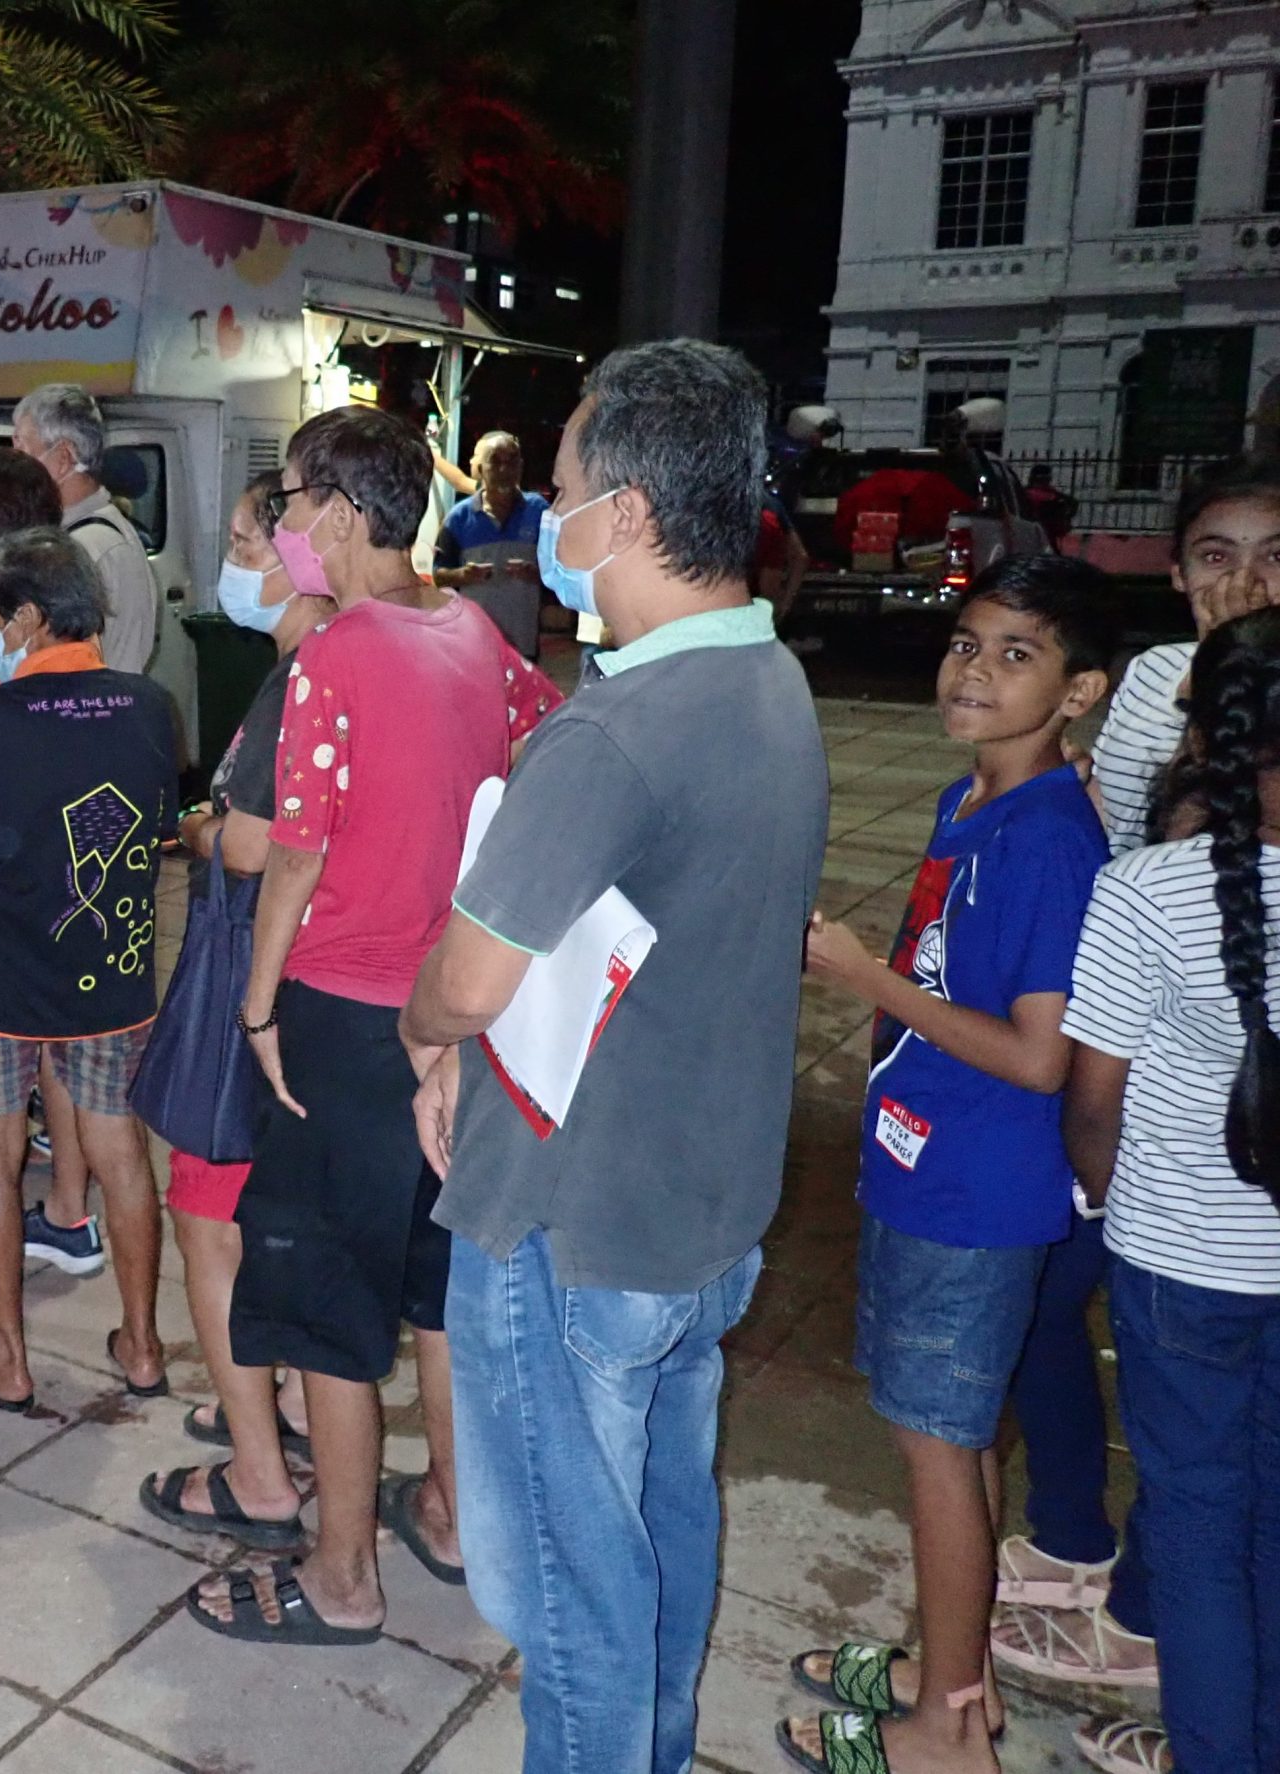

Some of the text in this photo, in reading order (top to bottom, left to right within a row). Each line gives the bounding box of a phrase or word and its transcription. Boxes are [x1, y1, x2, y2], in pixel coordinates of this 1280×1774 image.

[27, 696, 134, 712] WE ARE THE BEST
[893, 1105, 921, 1131] HELLO
[886, 1132, 913, 1163] PARKER
